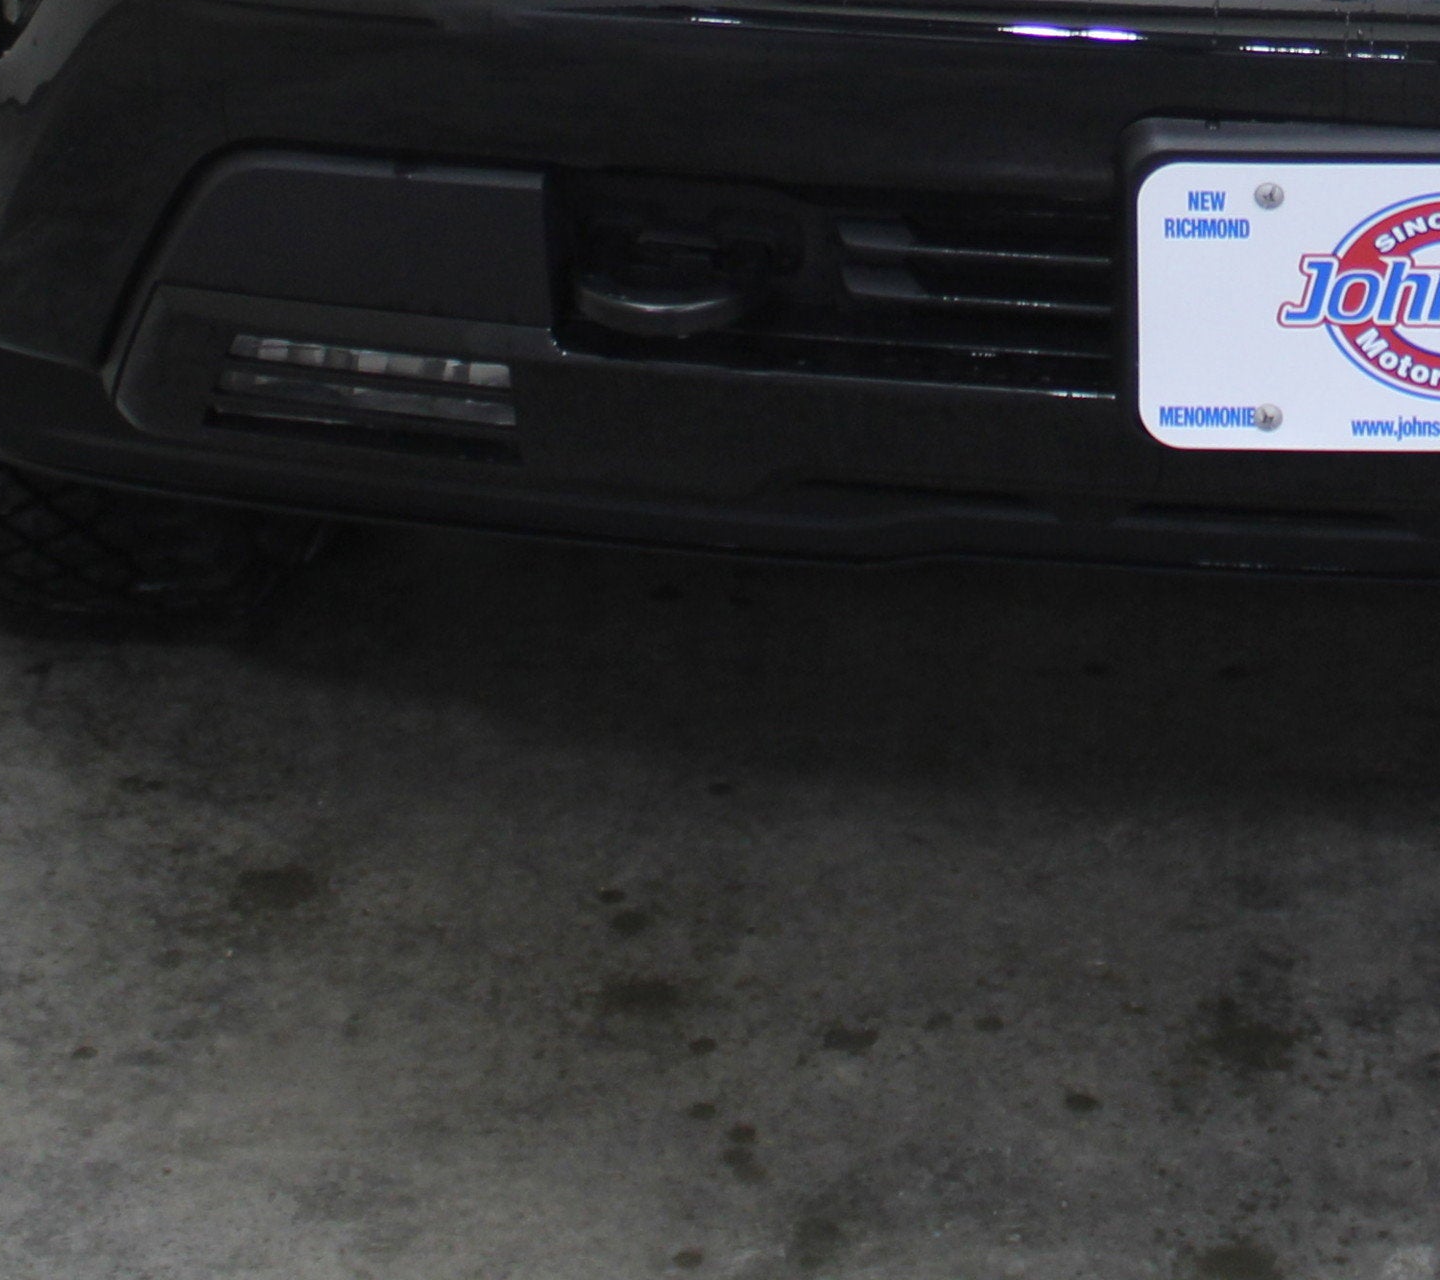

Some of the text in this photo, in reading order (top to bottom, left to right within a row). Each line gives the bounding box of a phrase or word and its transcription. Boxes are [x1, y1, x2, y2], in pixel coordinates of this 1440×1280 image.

[1187, 190, 1226, 212] NEW
[1164, 218, 1250, 239] RICHMOND
[1160, 406, 1257, 428] MENOMONIE
